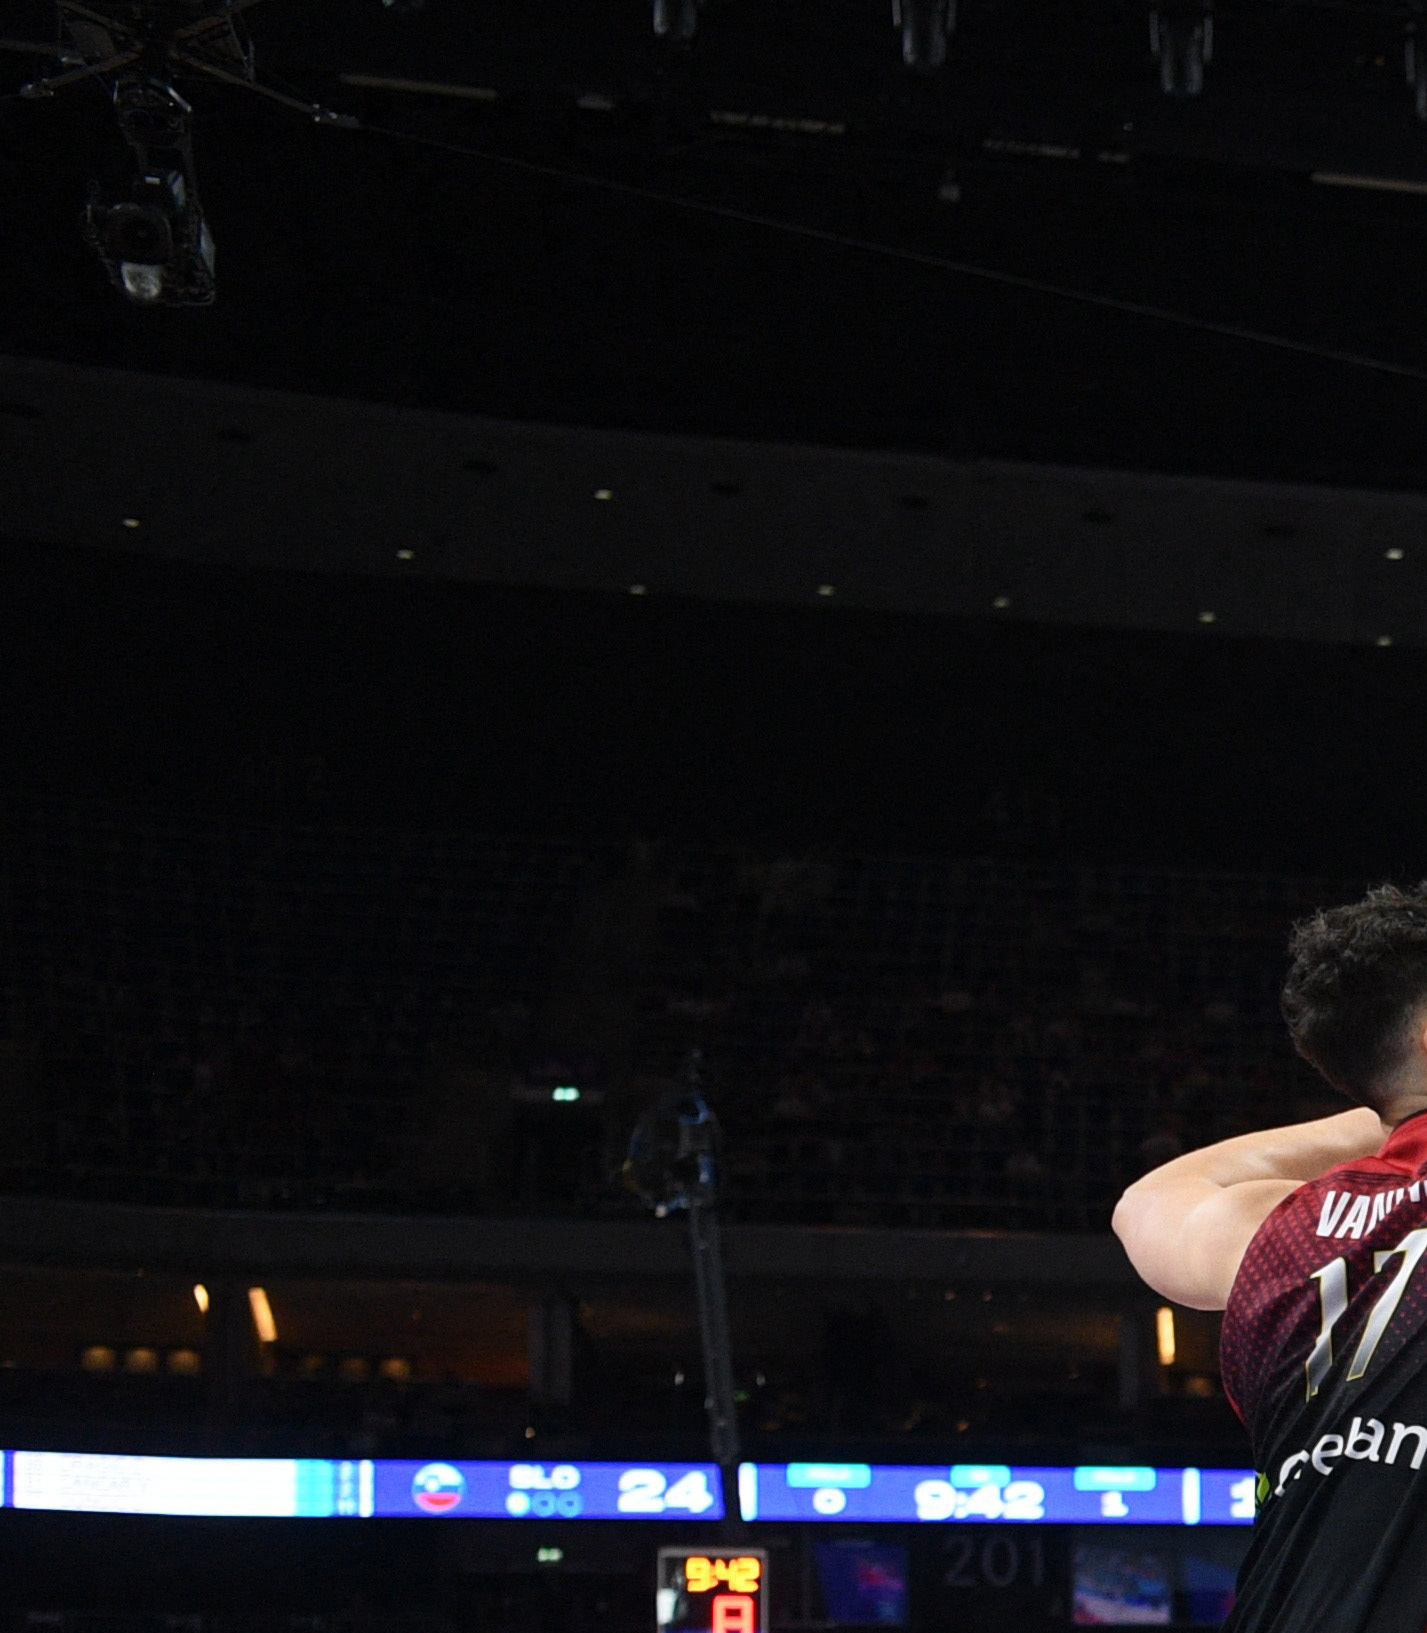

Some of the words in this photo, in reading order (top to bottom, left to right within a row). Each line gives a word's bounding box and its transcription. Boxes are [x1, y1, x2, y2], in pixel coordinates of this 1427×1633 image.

[509, 1464, 581, 1490] SLO
[618, 1468, 714, 1514] 24
[914, 1480, 1045, 1520] 9:42
[685, 1556, 761, 1593] 9:42
